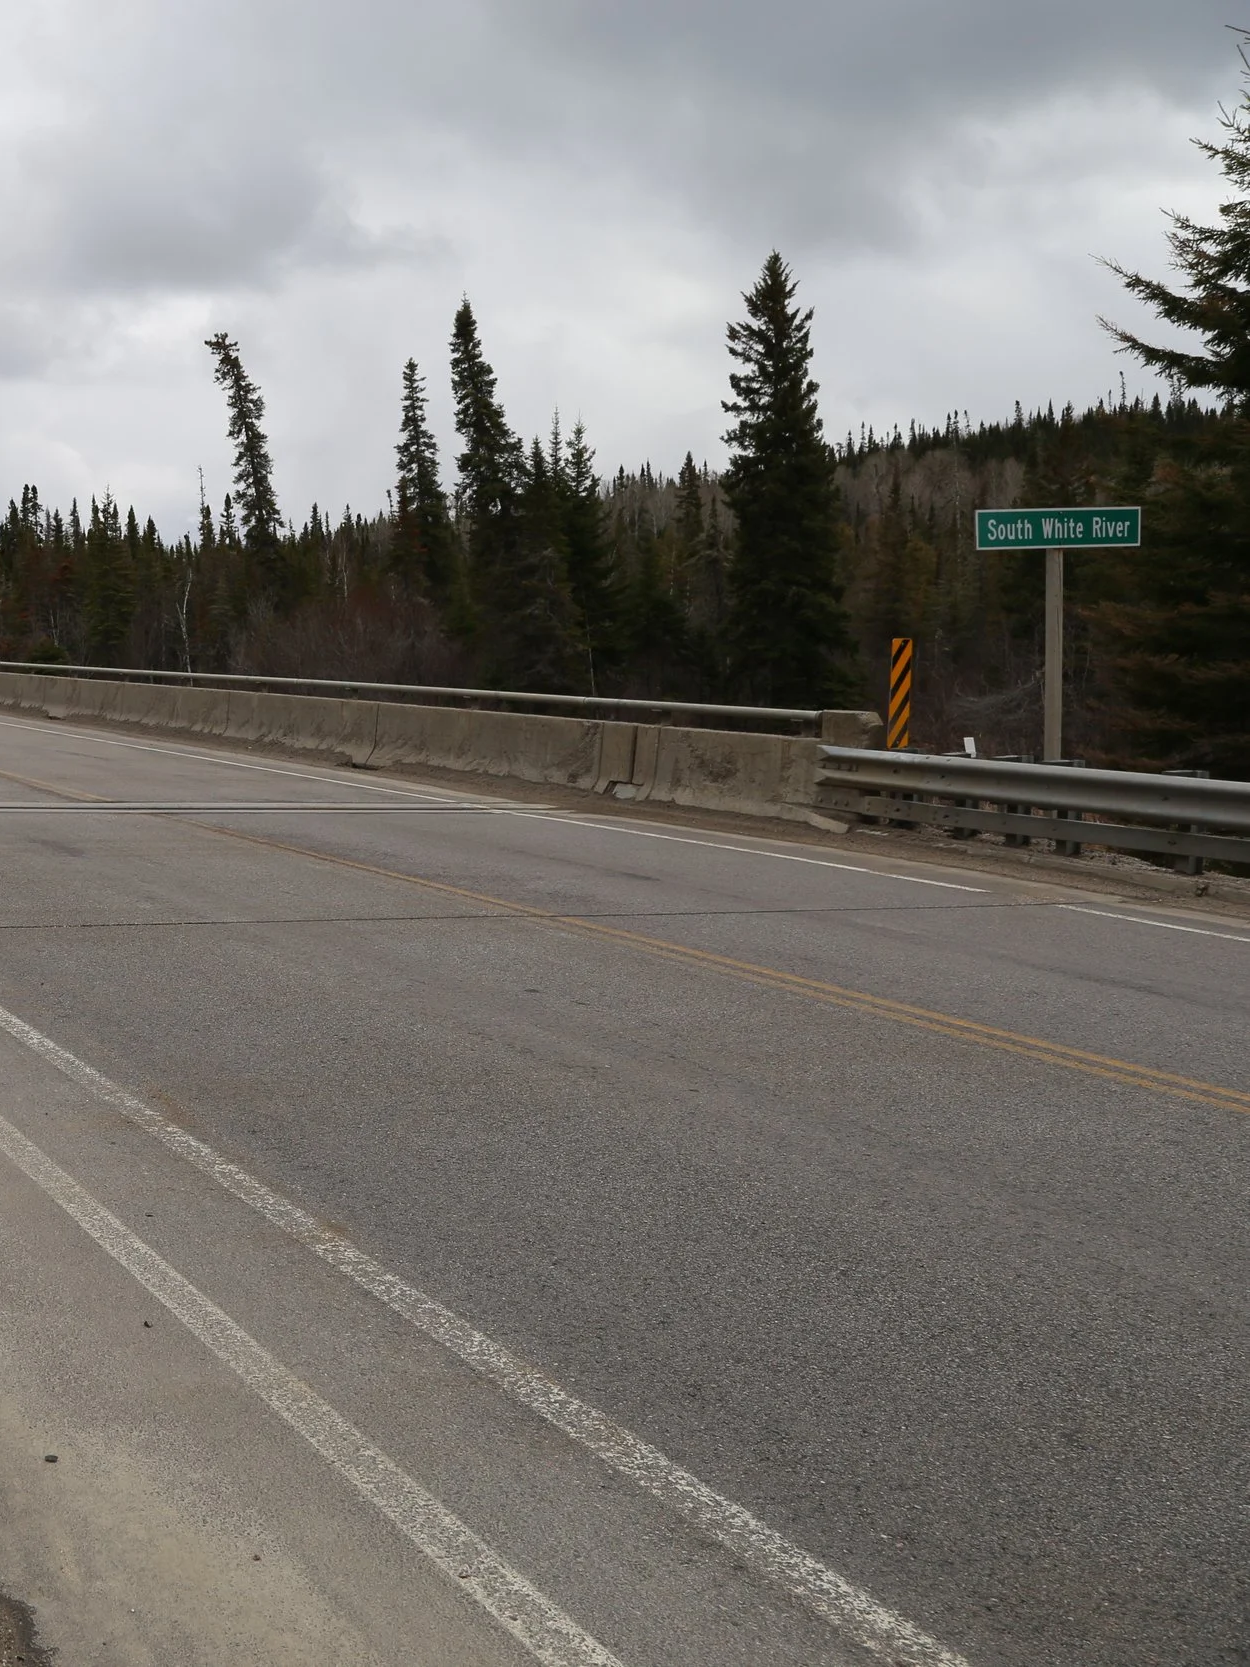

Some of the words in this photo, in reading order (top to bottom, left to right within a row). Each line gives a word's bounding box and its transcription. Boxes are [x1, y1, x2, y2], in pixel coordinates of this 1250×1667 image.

[987, 518, 1033, 541] South
[1041, 517, 1084, 539] White
[1092, 516, 1131, 538] River
